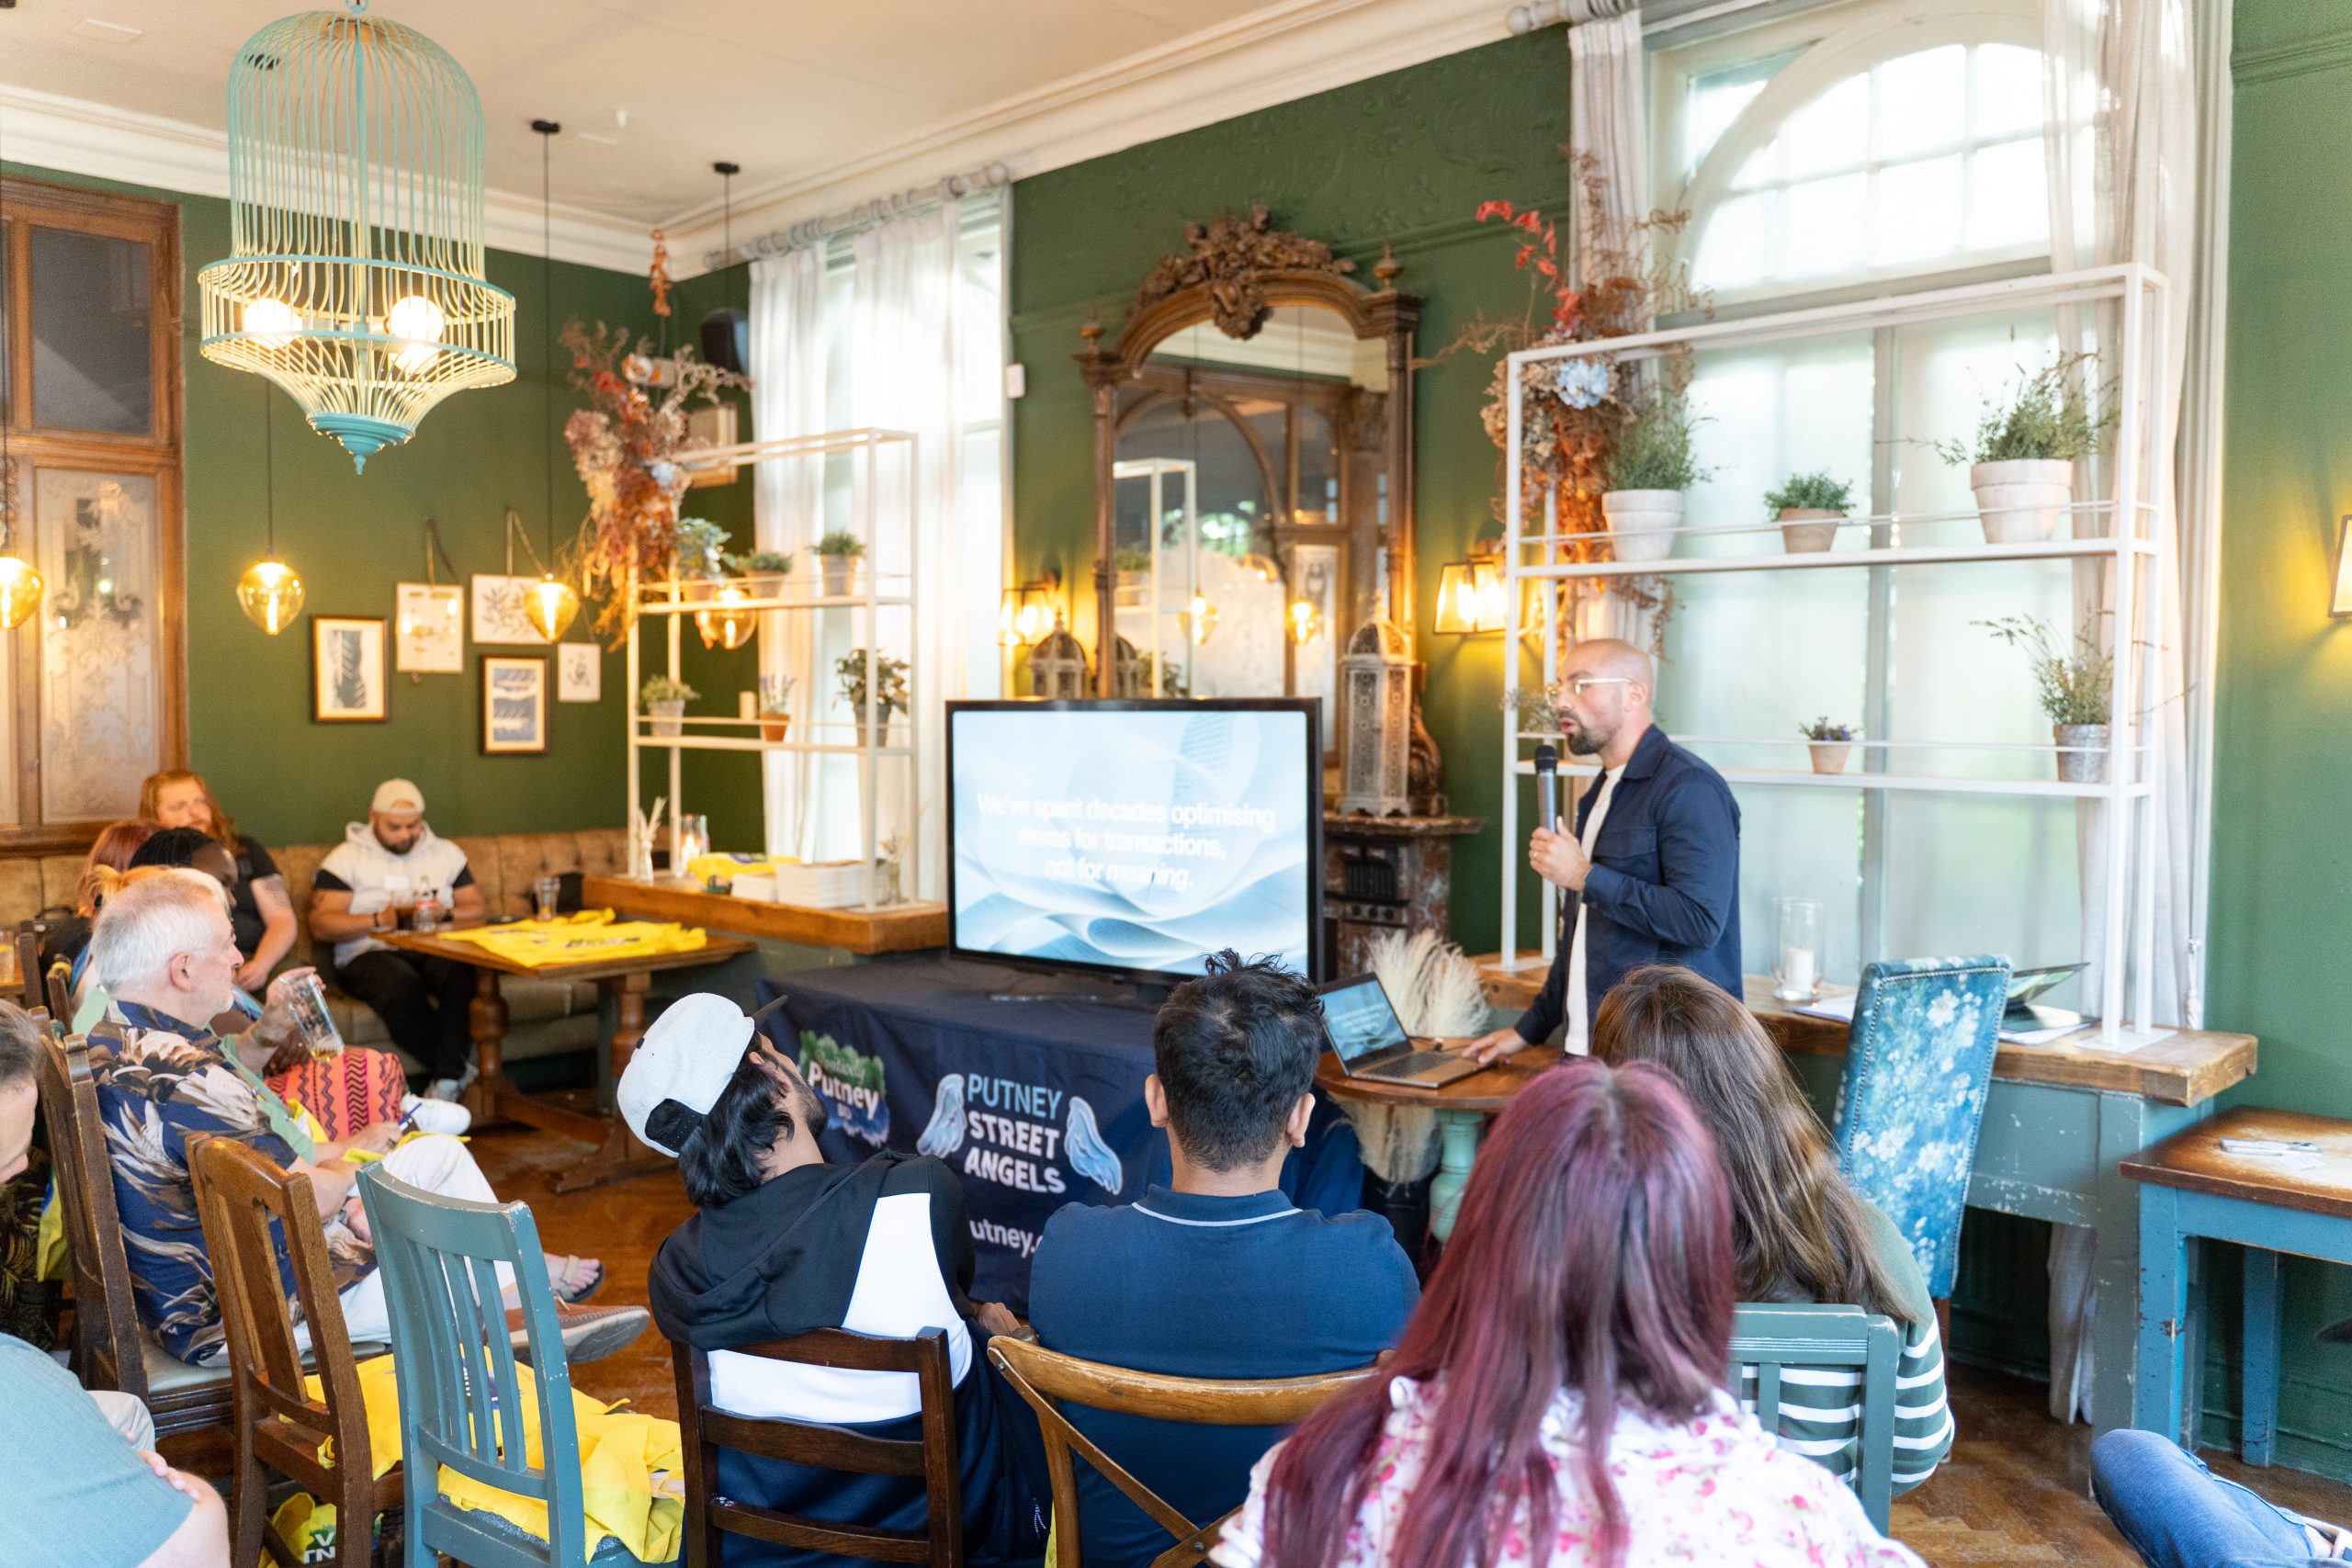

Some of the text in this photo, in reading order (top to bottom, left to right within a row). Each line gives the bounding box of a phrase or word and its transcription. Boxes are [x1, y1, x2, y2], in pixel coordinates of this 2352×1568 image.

[1033, 796, 1082, 823] spent
[1086, 796, 1166, 824] decades
[1170, 798, 1277, 834] optimising
[1016, 825, 1227, 862] stores for transactions,
[1045, 855, 1194, 892] not for meaning.
[808, 1060, 879, 1121] Putney
[967, 1072, 1063, 1120] PUTNEY
[967, 1110, 1060, 1159] STREET
[964, 1145, 1067, 1194] ANGELS
